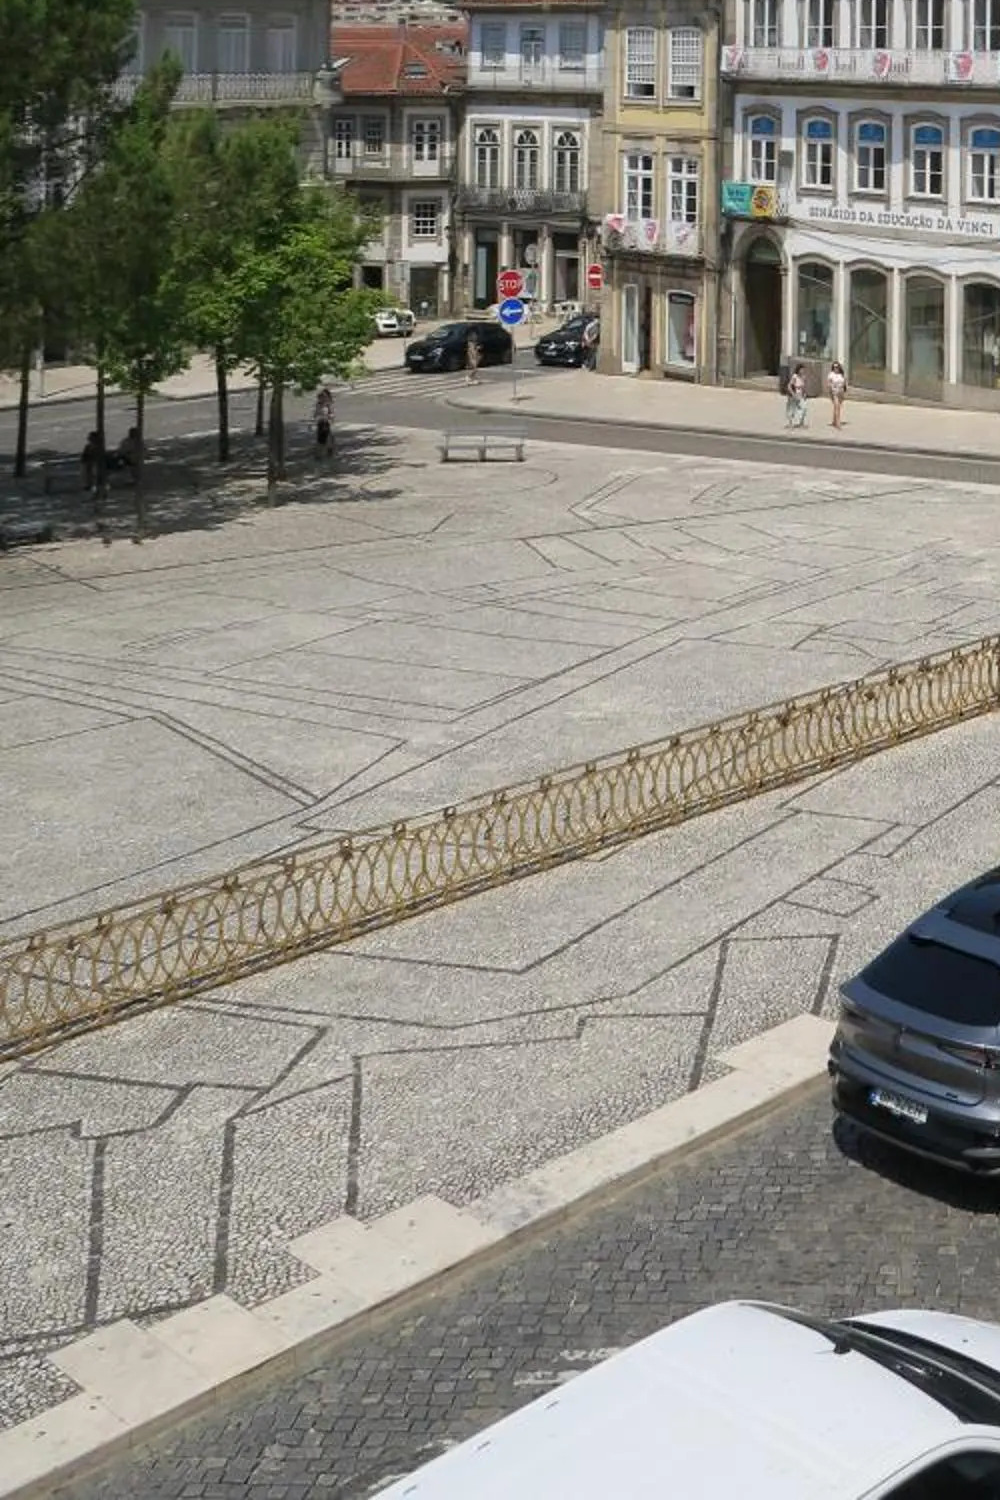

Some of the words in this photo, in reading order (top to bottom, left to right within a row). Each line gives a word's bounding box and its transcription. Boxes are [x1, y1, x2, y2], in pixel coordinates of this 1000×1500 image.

[860, 211, 874, 223] DA
[937, 219, 952, 231] DA
[957, 220, 993, 235] VINCI
